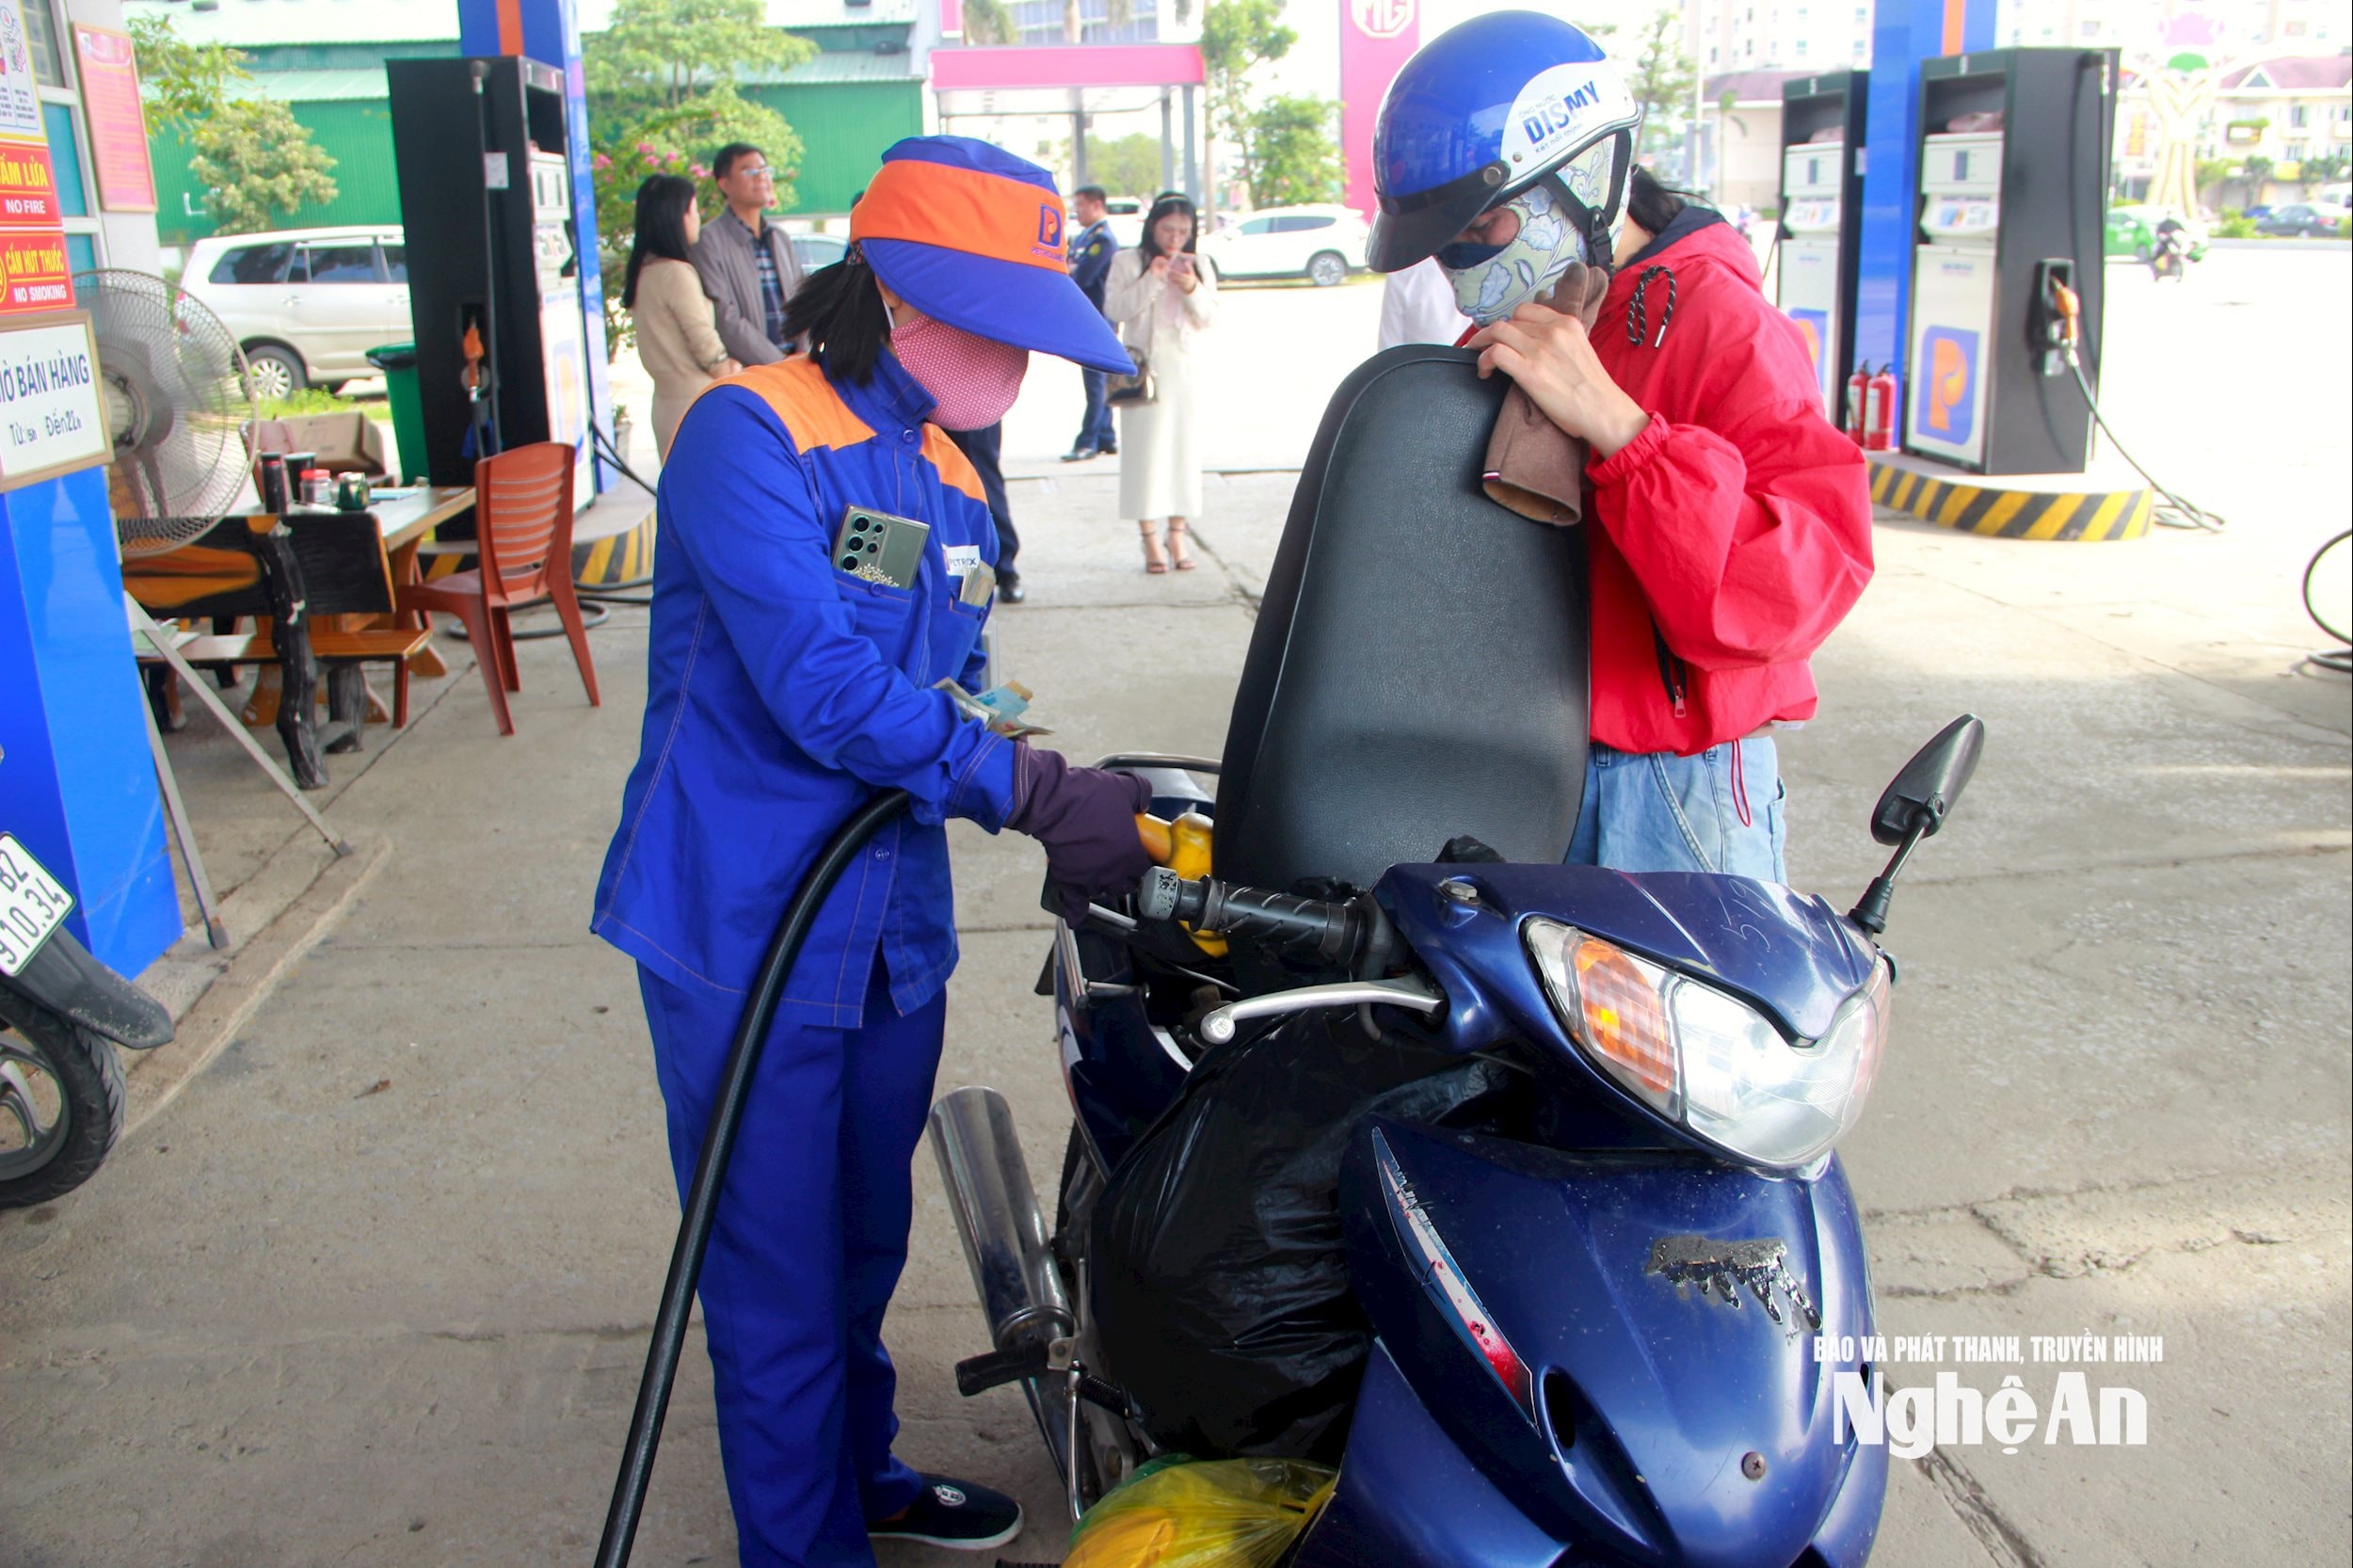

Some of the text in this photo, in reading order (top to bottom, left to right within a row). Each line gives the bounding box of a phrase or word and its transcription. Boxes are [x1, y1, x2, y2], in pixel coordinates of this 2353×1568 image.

[1522, 80, 1600, 145] DISMY
[0, 152, 49, 187] ẤM LỬA
[6, 199, 46, 215] NO FIRE
[6, 241, 65, 275] CẤM HÚT THUỐC
[14, 283, 67, 303] NO SMOKING
[0, 349, 89, 403] IỜ BÁN HÀNG
